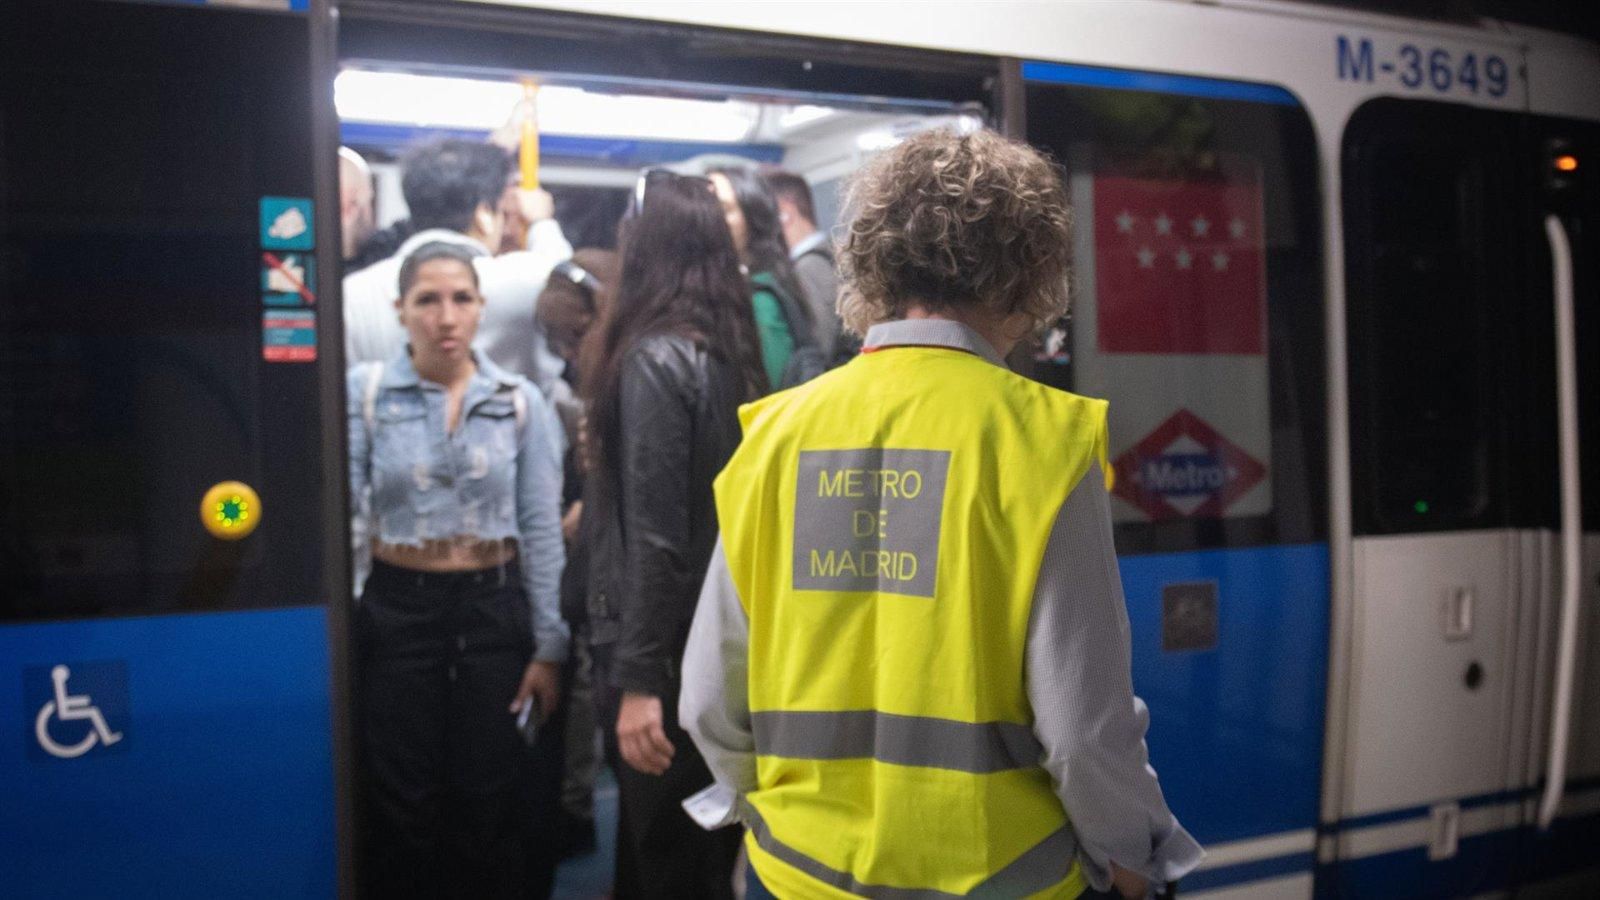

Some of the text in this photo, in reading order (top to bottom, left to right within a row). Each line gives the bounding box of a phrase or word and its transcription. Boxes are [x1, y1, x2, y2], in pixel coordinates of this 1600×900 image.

[1337, 35, 1508, 97] M-3649
[818, 469, 922, 499] METRO
[1146, 460, 1225, 489] Metro
[853, 509, 888, 538] DE
[810, 550, 918, 581] MADRID
